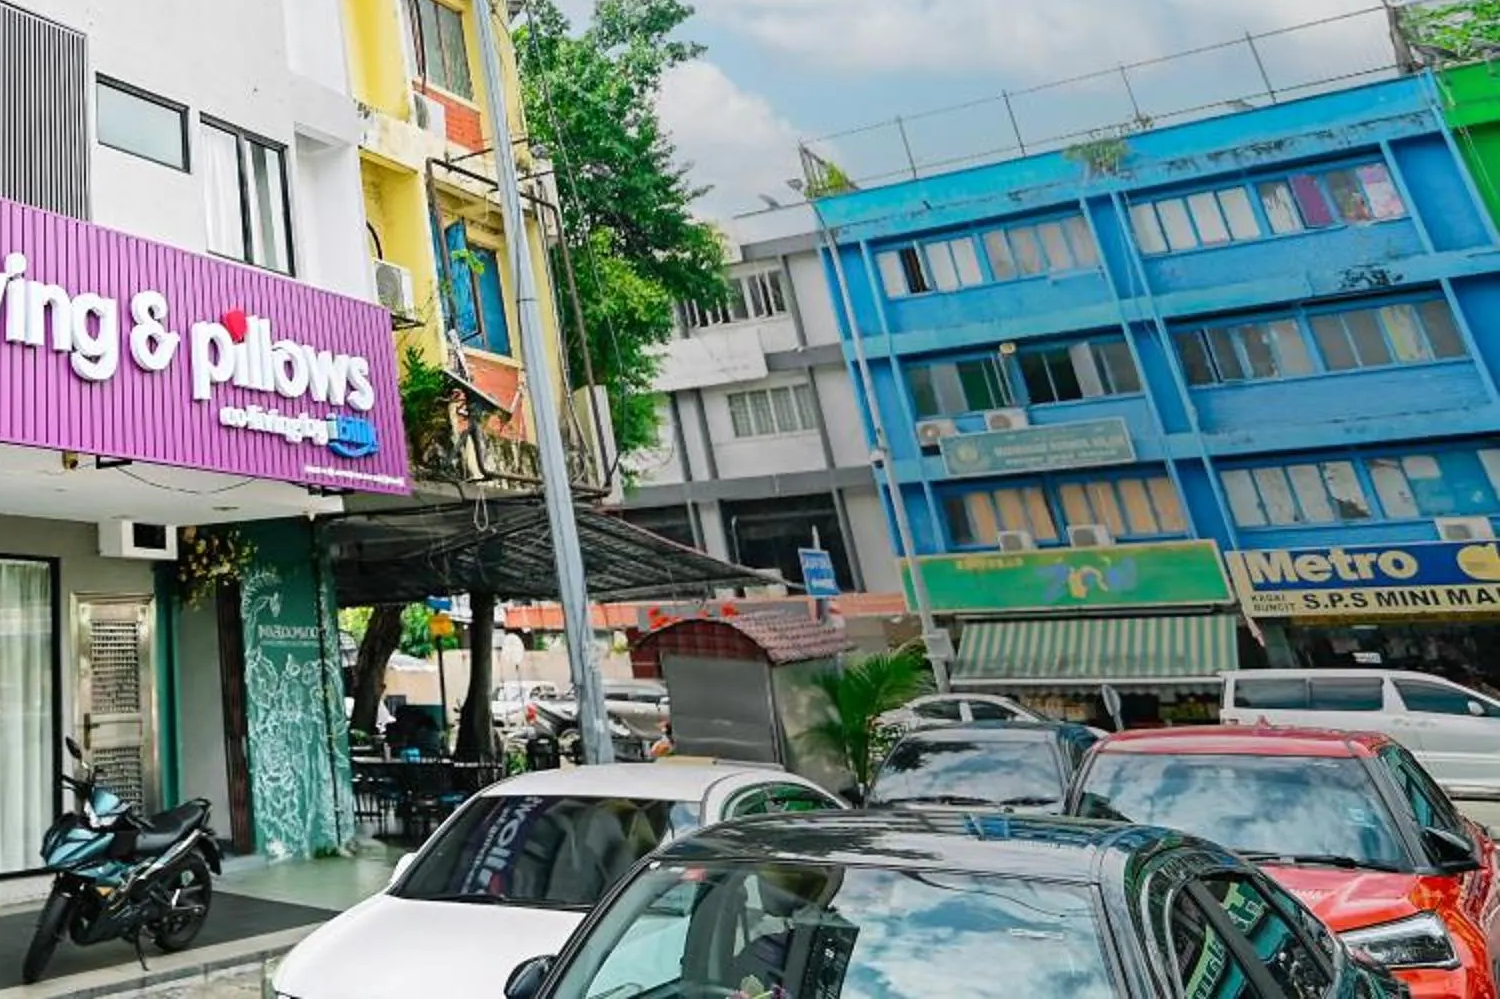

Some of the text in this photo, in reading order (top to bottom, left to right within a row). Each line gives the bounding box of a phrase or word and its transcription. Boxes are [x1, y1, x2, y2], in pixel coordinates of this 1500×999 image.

[130, 289, 181, 372] &
[191, 305, 376, 411] pillows
[1250, 547, 1419, 584] Metro
[1303, 587, 1500, 610] S.P.S MINI MA
